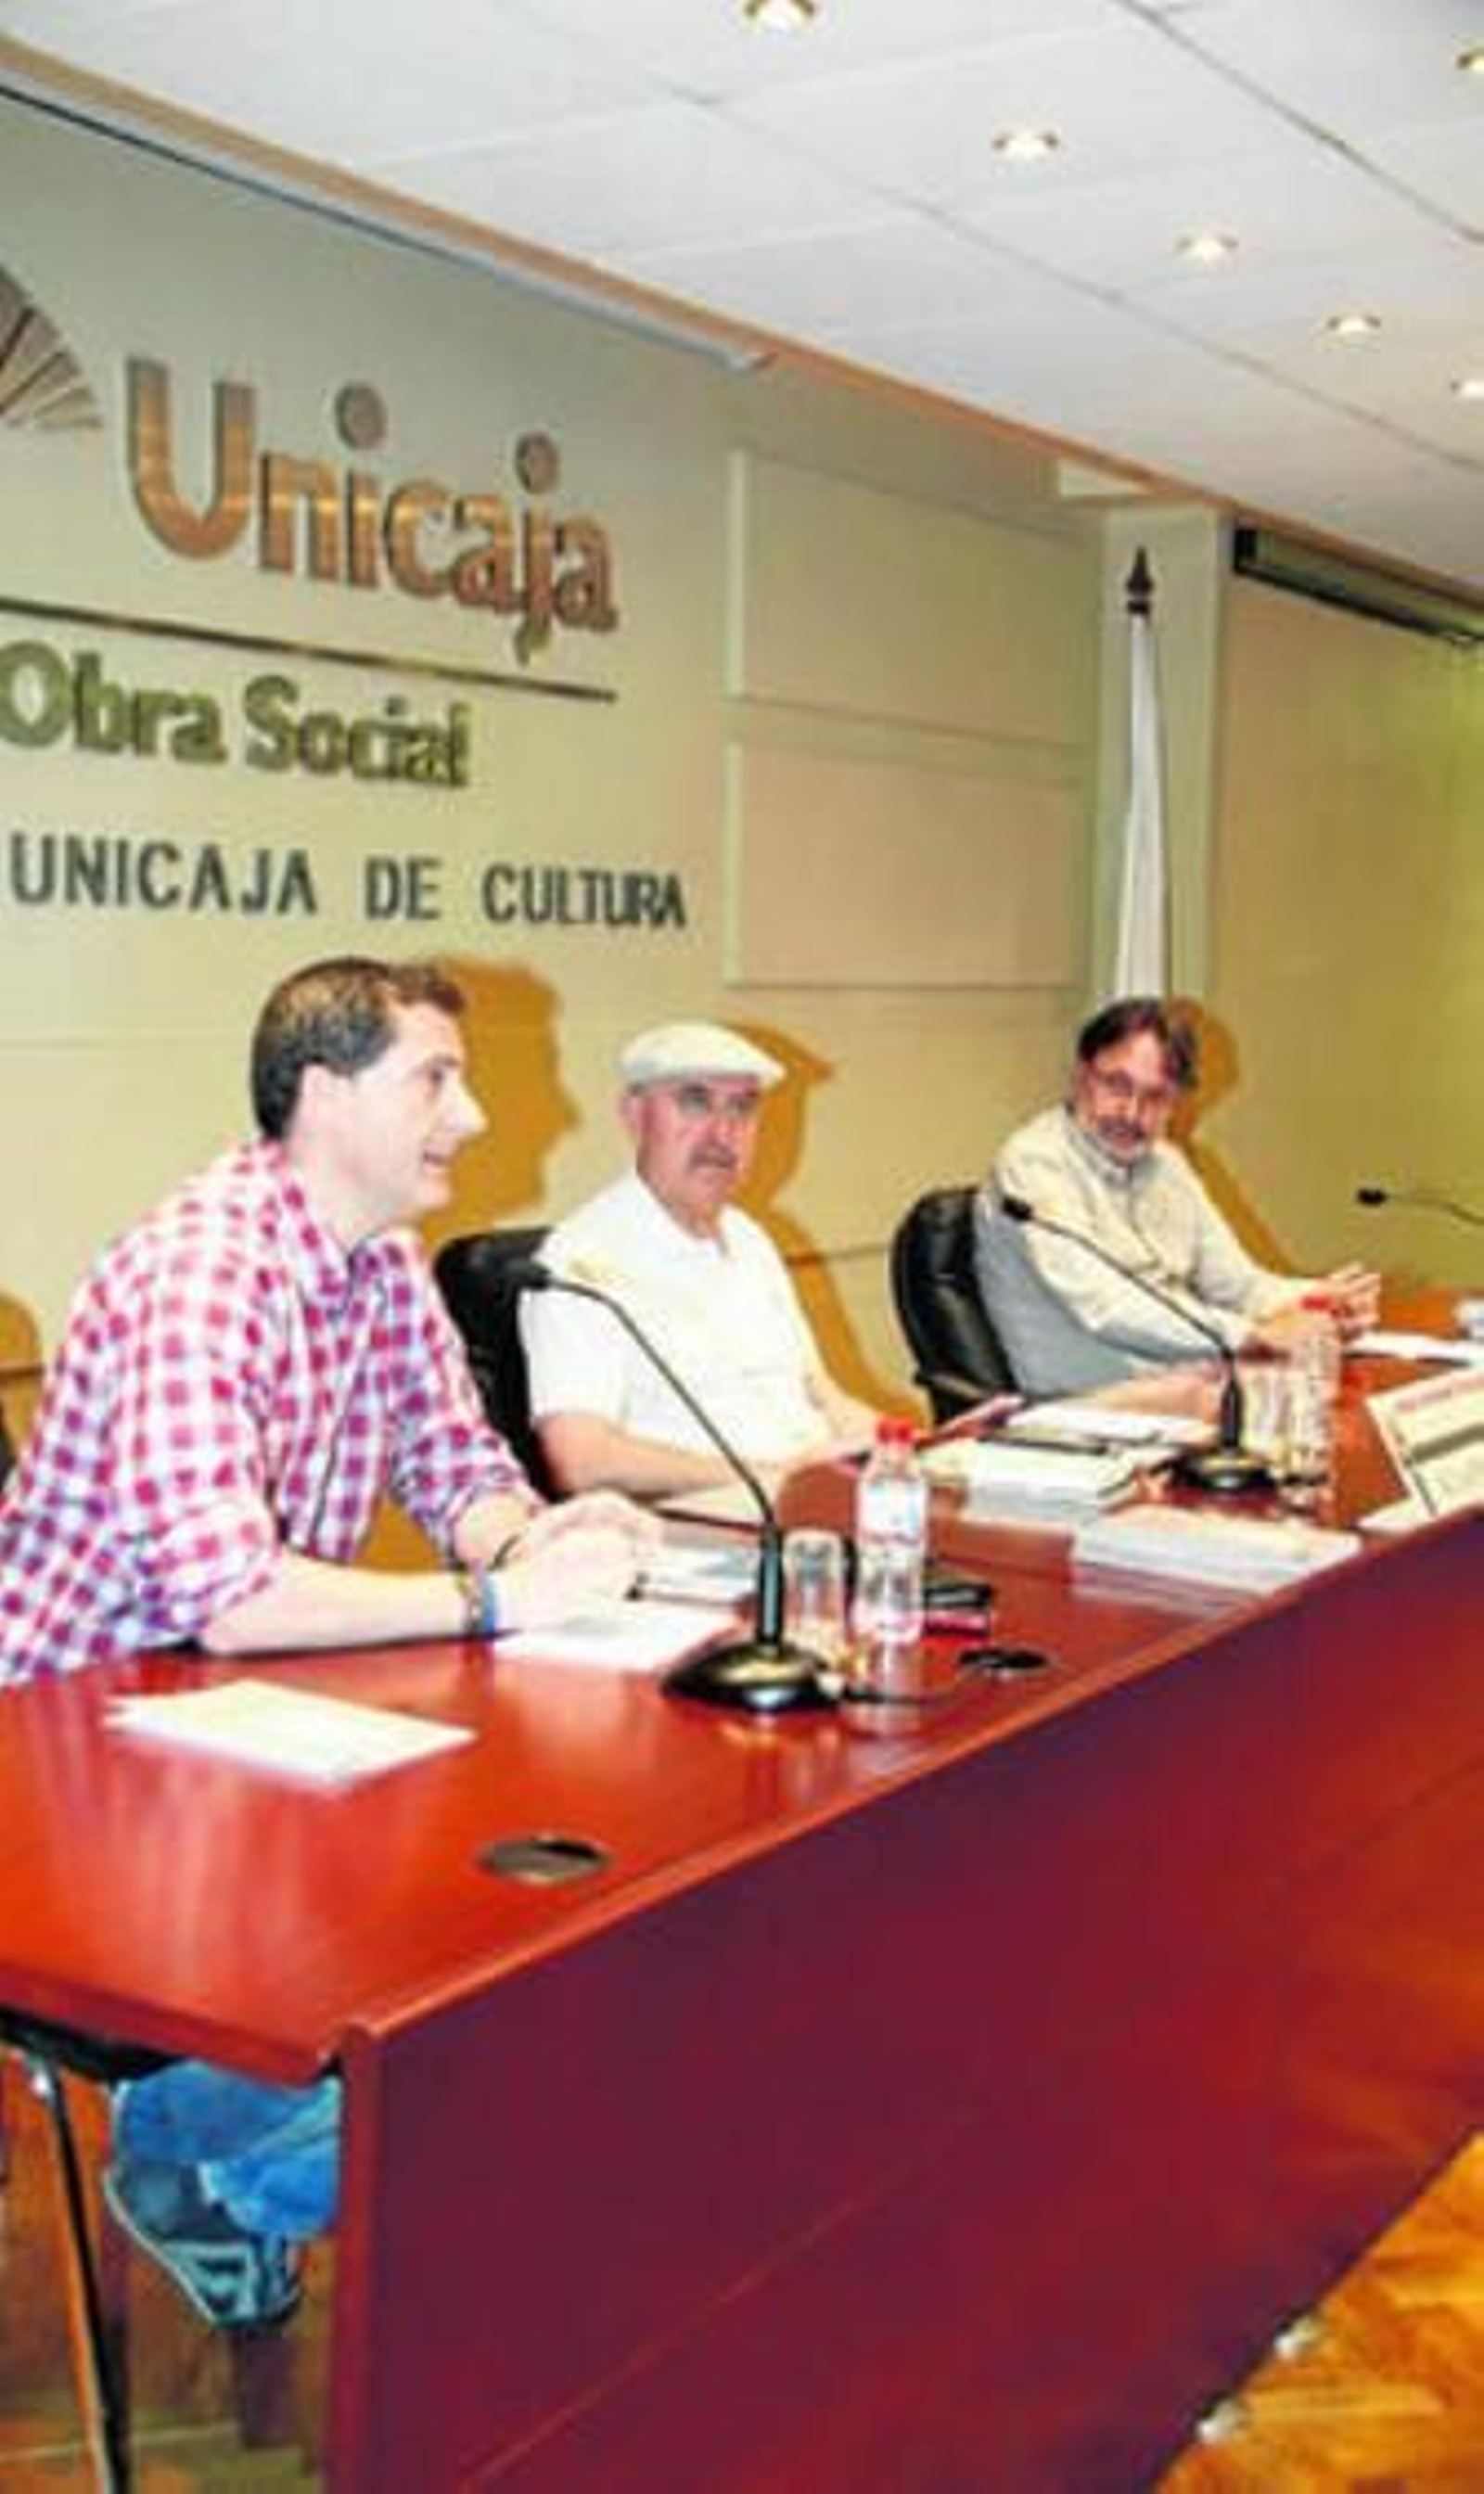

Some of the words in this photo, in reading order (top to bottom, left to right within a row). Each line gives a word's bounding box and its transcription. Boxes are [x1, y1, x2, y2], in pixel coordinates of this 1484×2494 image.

[125, 358, 619, 664] Unicaja
[0, 640, 226, 764] Obra
[243, 675, 469, 788] Social
[9, 832, 318, 915] UNICAJA
[364, 857, 441, 921] DE
[482, 863, 687, 928] CULTURA
